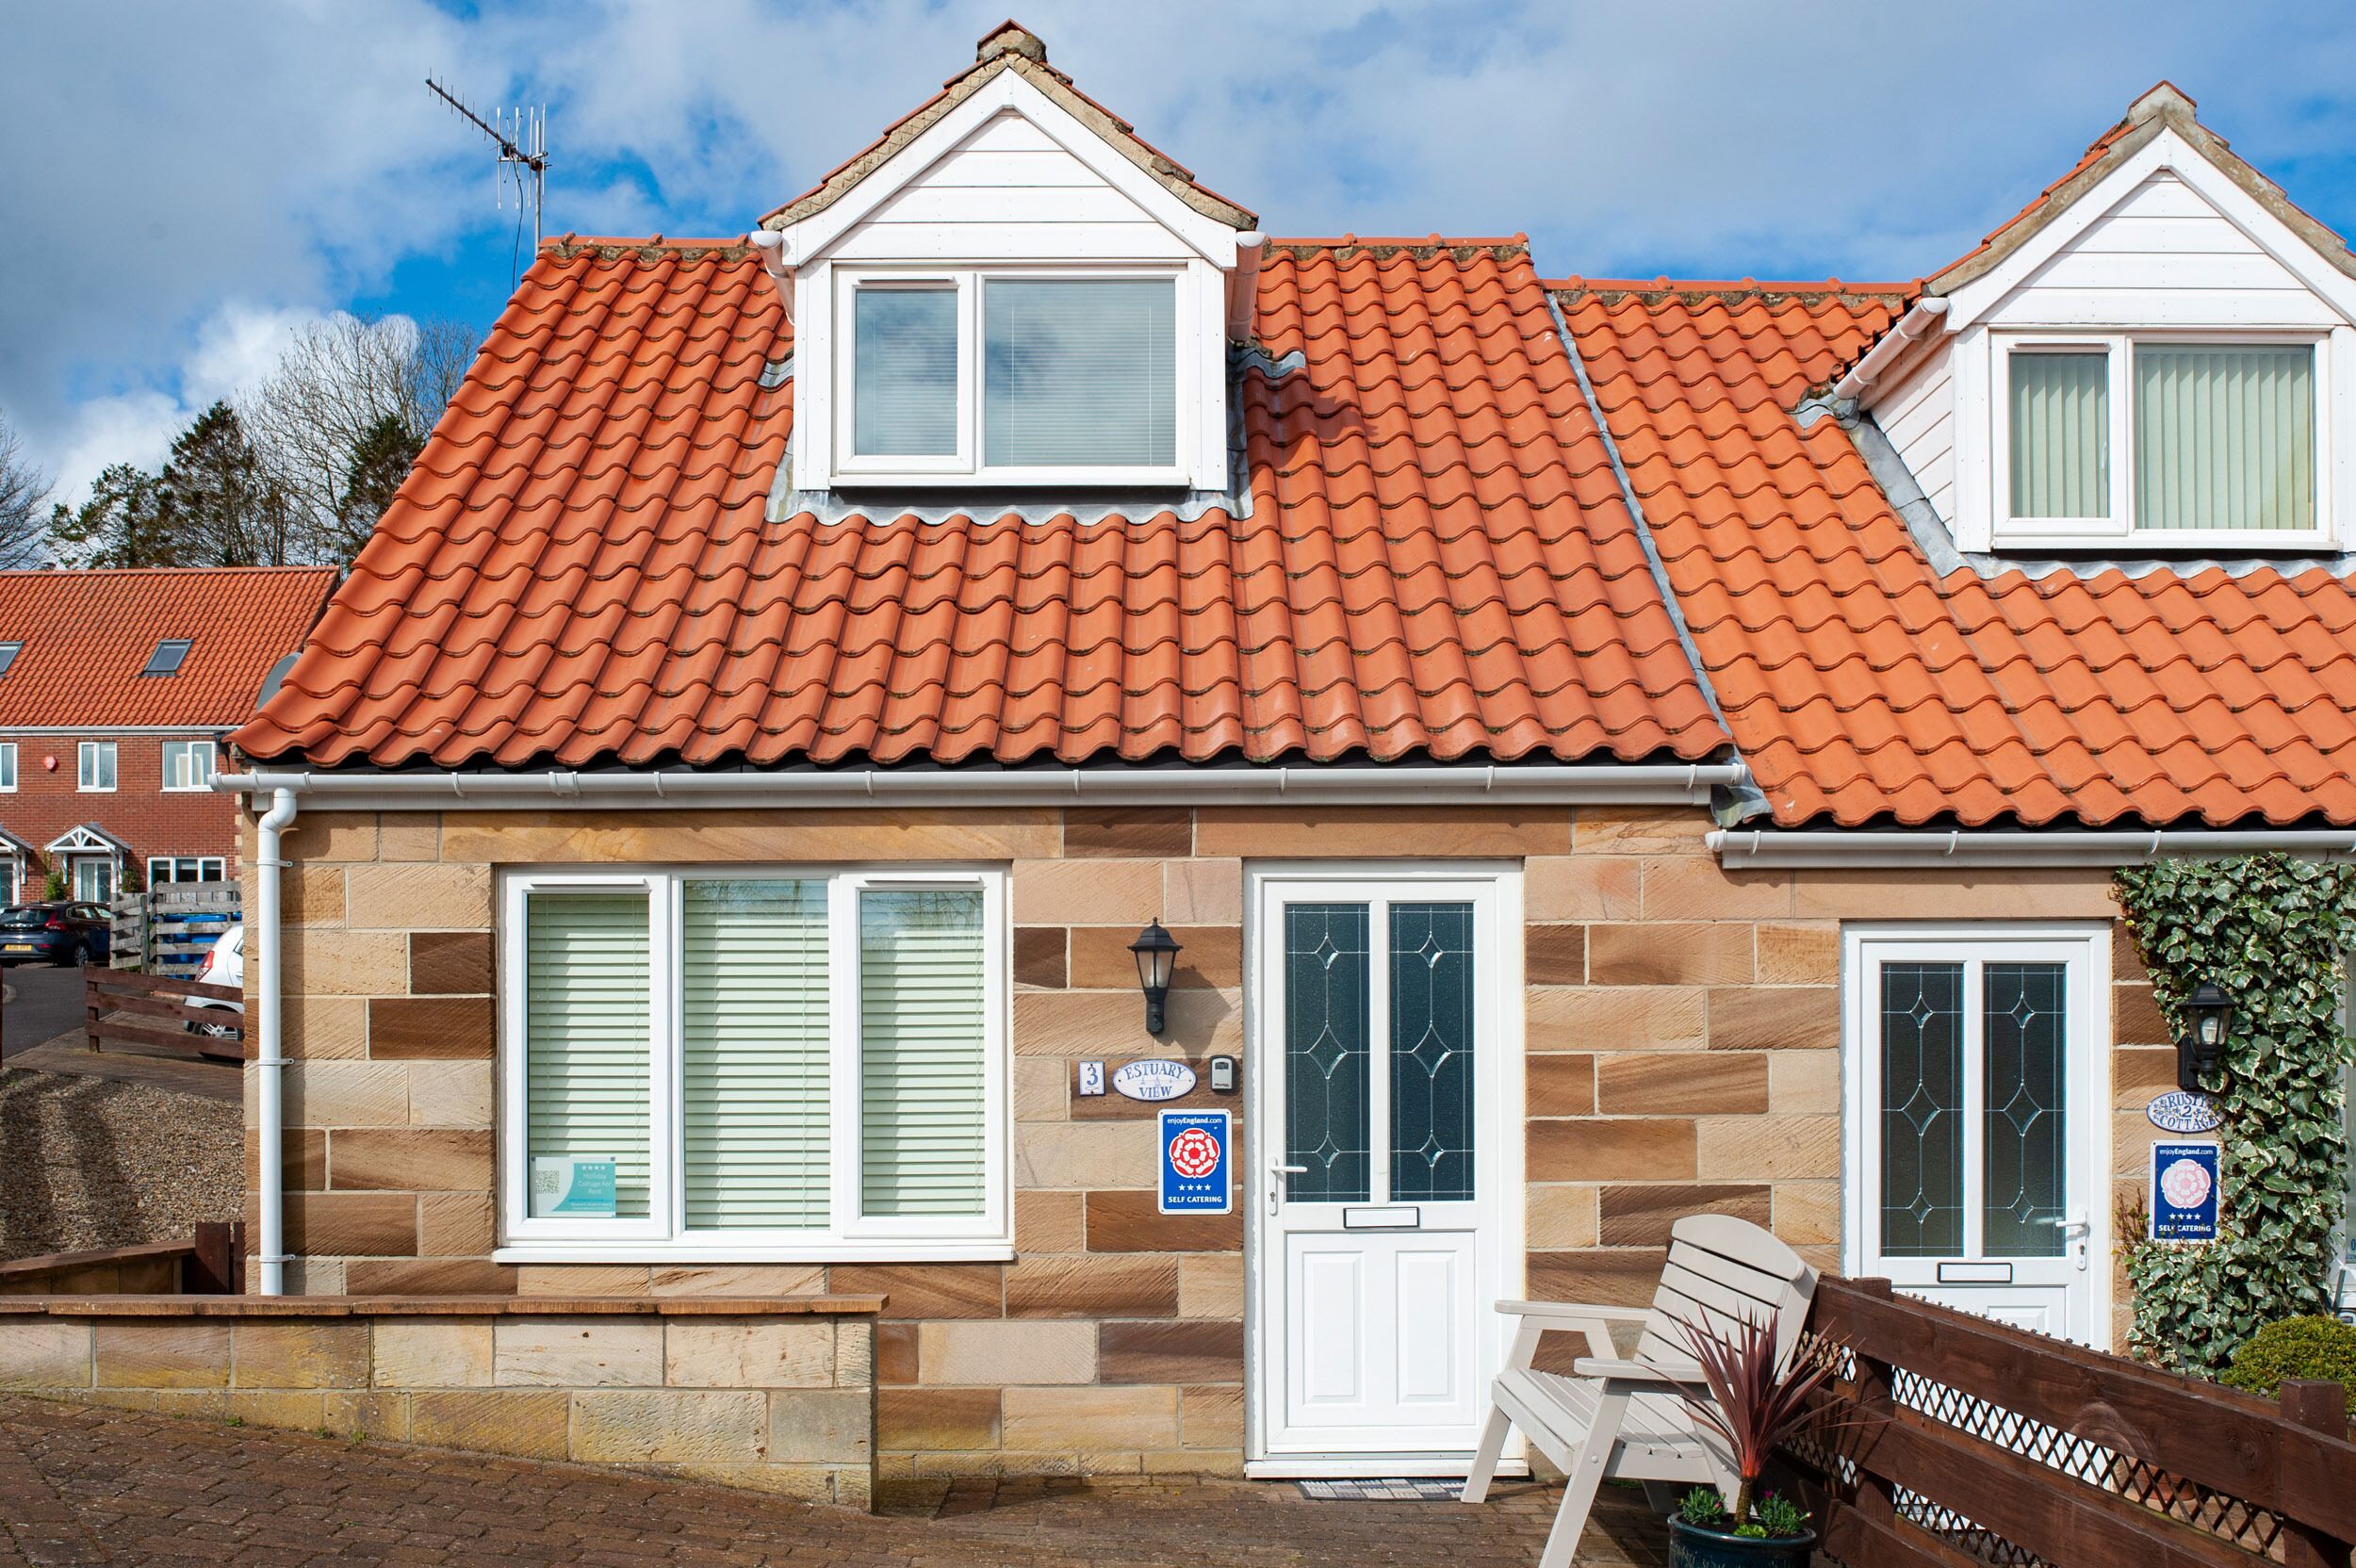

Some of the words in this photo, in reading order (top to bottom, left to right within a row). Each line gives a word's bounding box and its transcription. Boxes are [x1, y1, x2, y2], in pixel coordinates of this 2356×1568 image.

[1087, 1066, 1098, 1086] 3
[1124, 1063, 1187, 1080] ESTUARY
[1138, 1086, 1172, 1098] VIEW
[2168, 1094, 2206, 1107] RUSTY
[2182, 1105, 2193, 1118] 2
[2159, 1148, 2213, 1156] enjoyEngland.com
